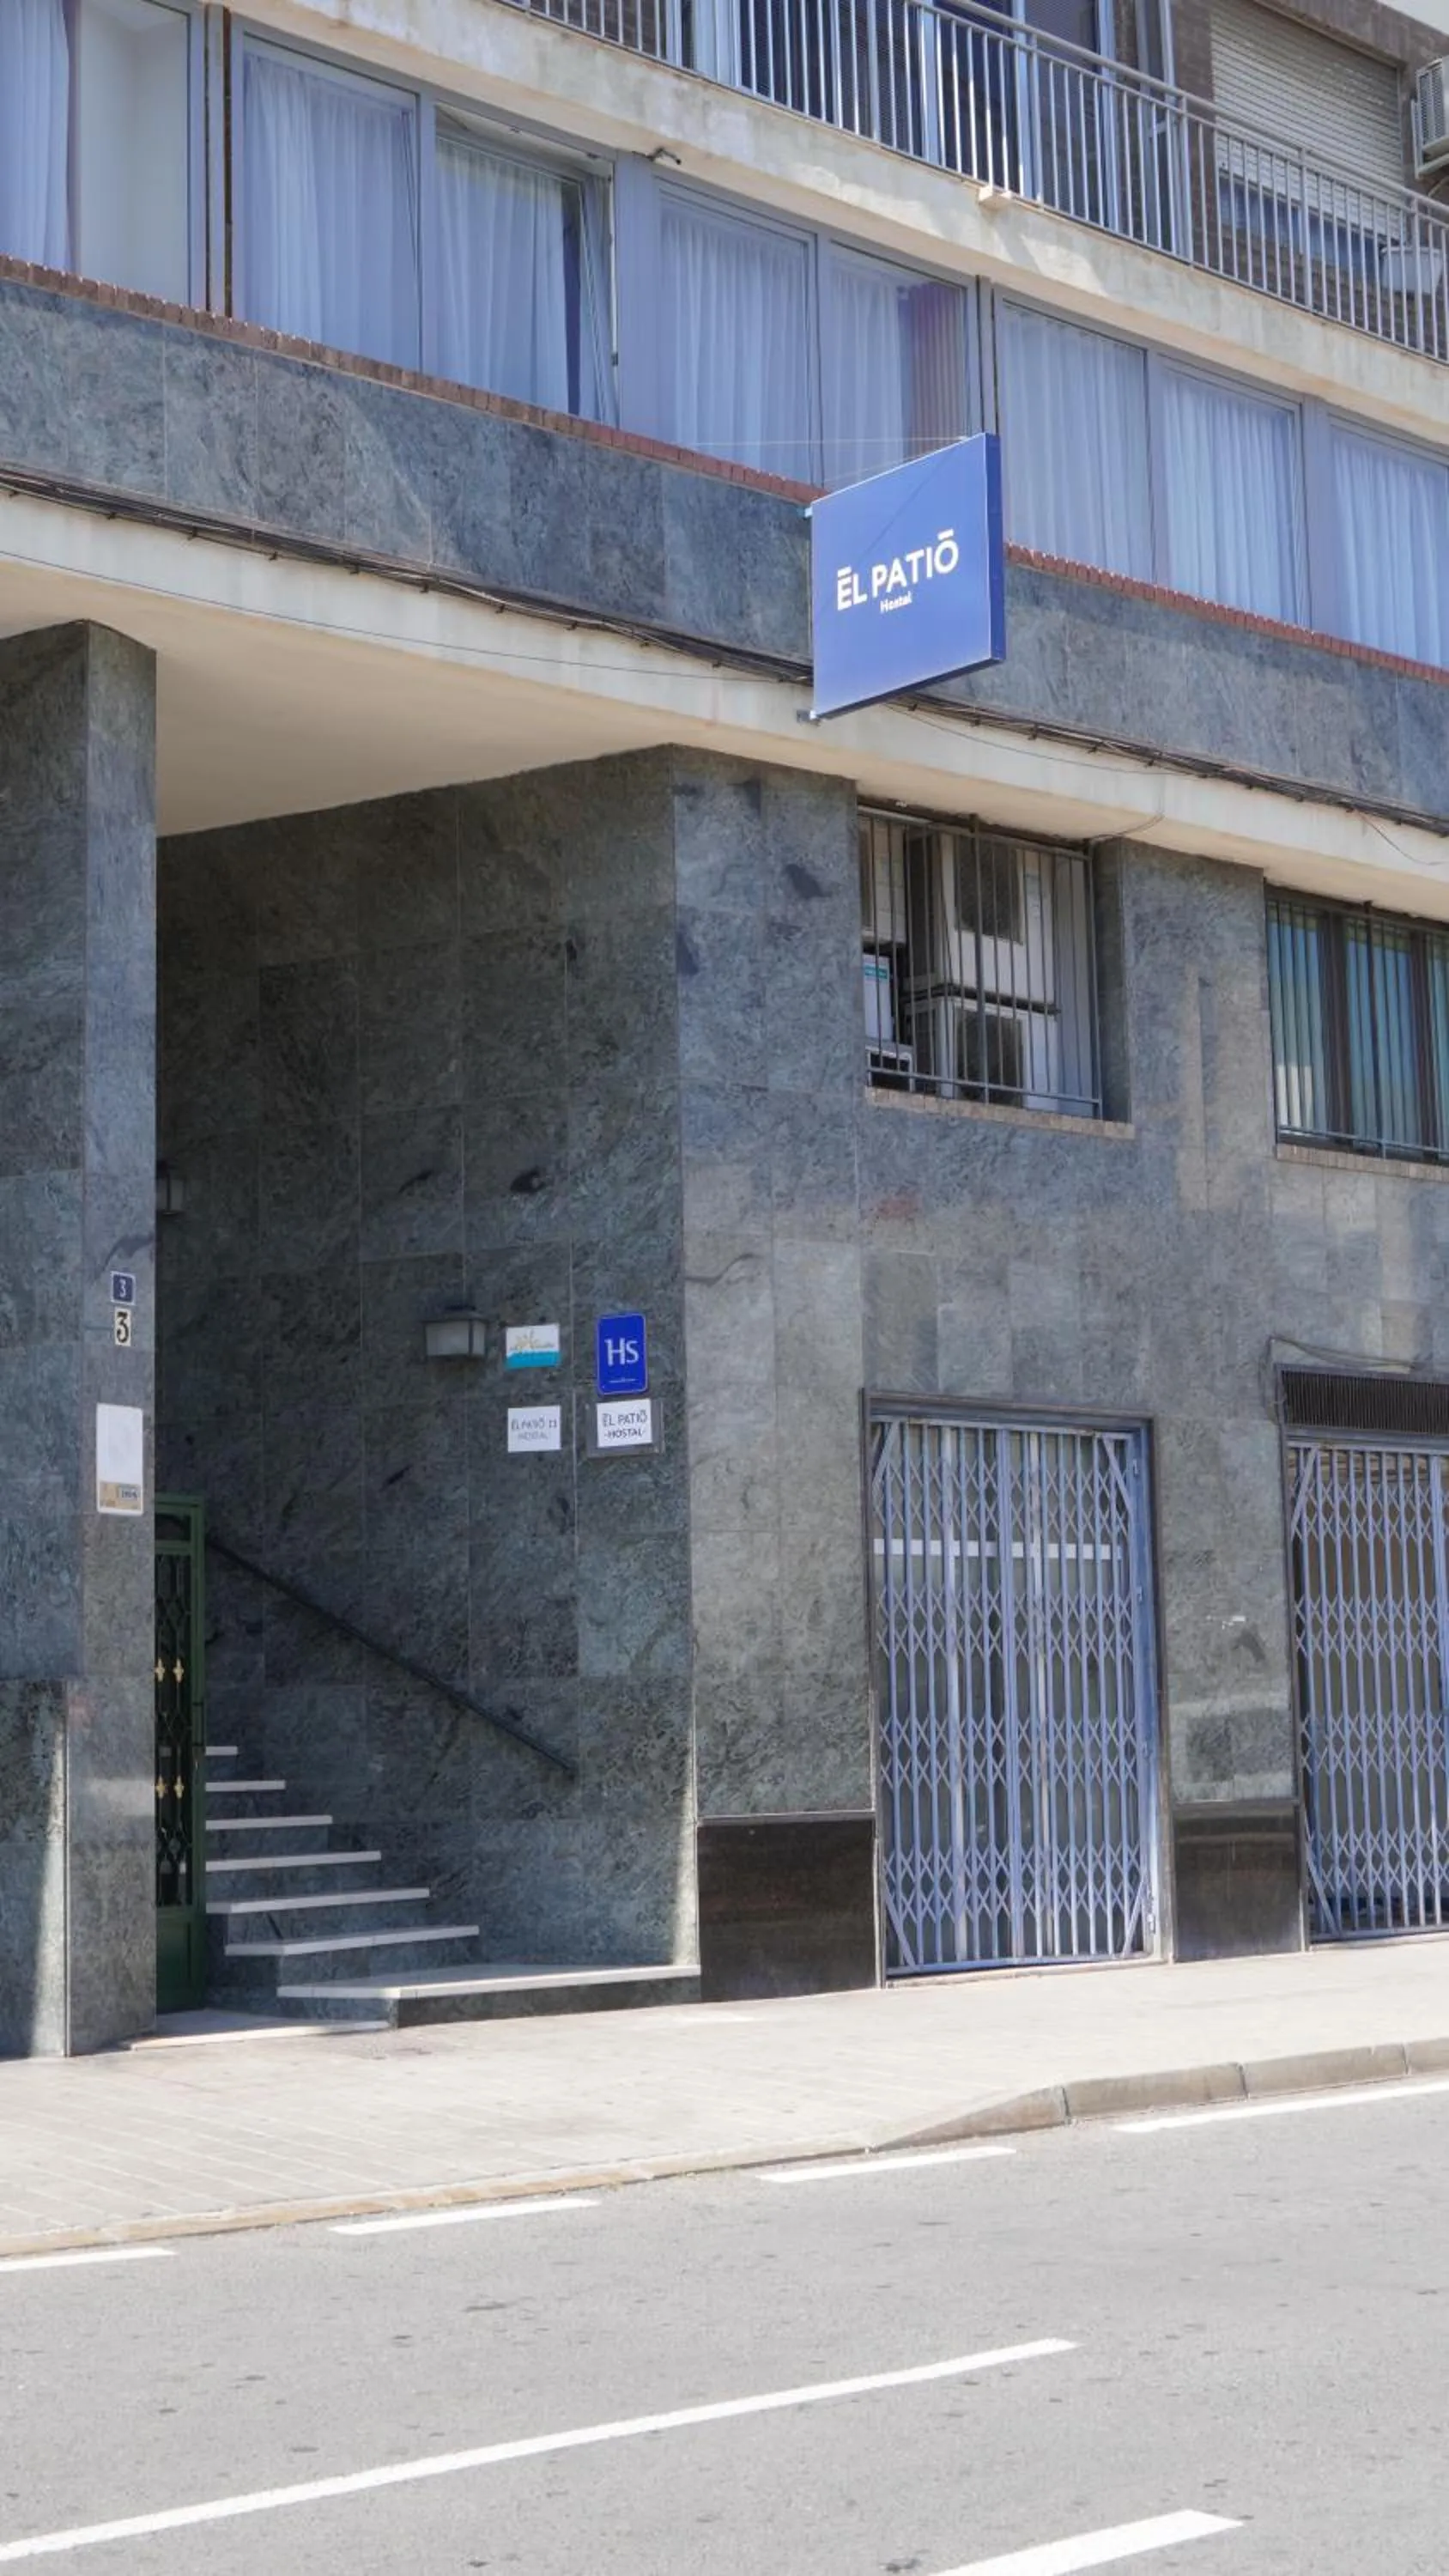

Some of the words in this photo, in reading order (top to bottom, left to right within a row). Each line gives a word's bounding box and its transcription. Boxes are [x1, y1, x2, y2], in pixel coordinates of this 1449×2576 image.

[880, 590, 912, 613] Hostal
[118, 1279, 126, 1297] 3
[117, 1311, 129, 1343] 3
[603, 1337, 640, 1367] HS
